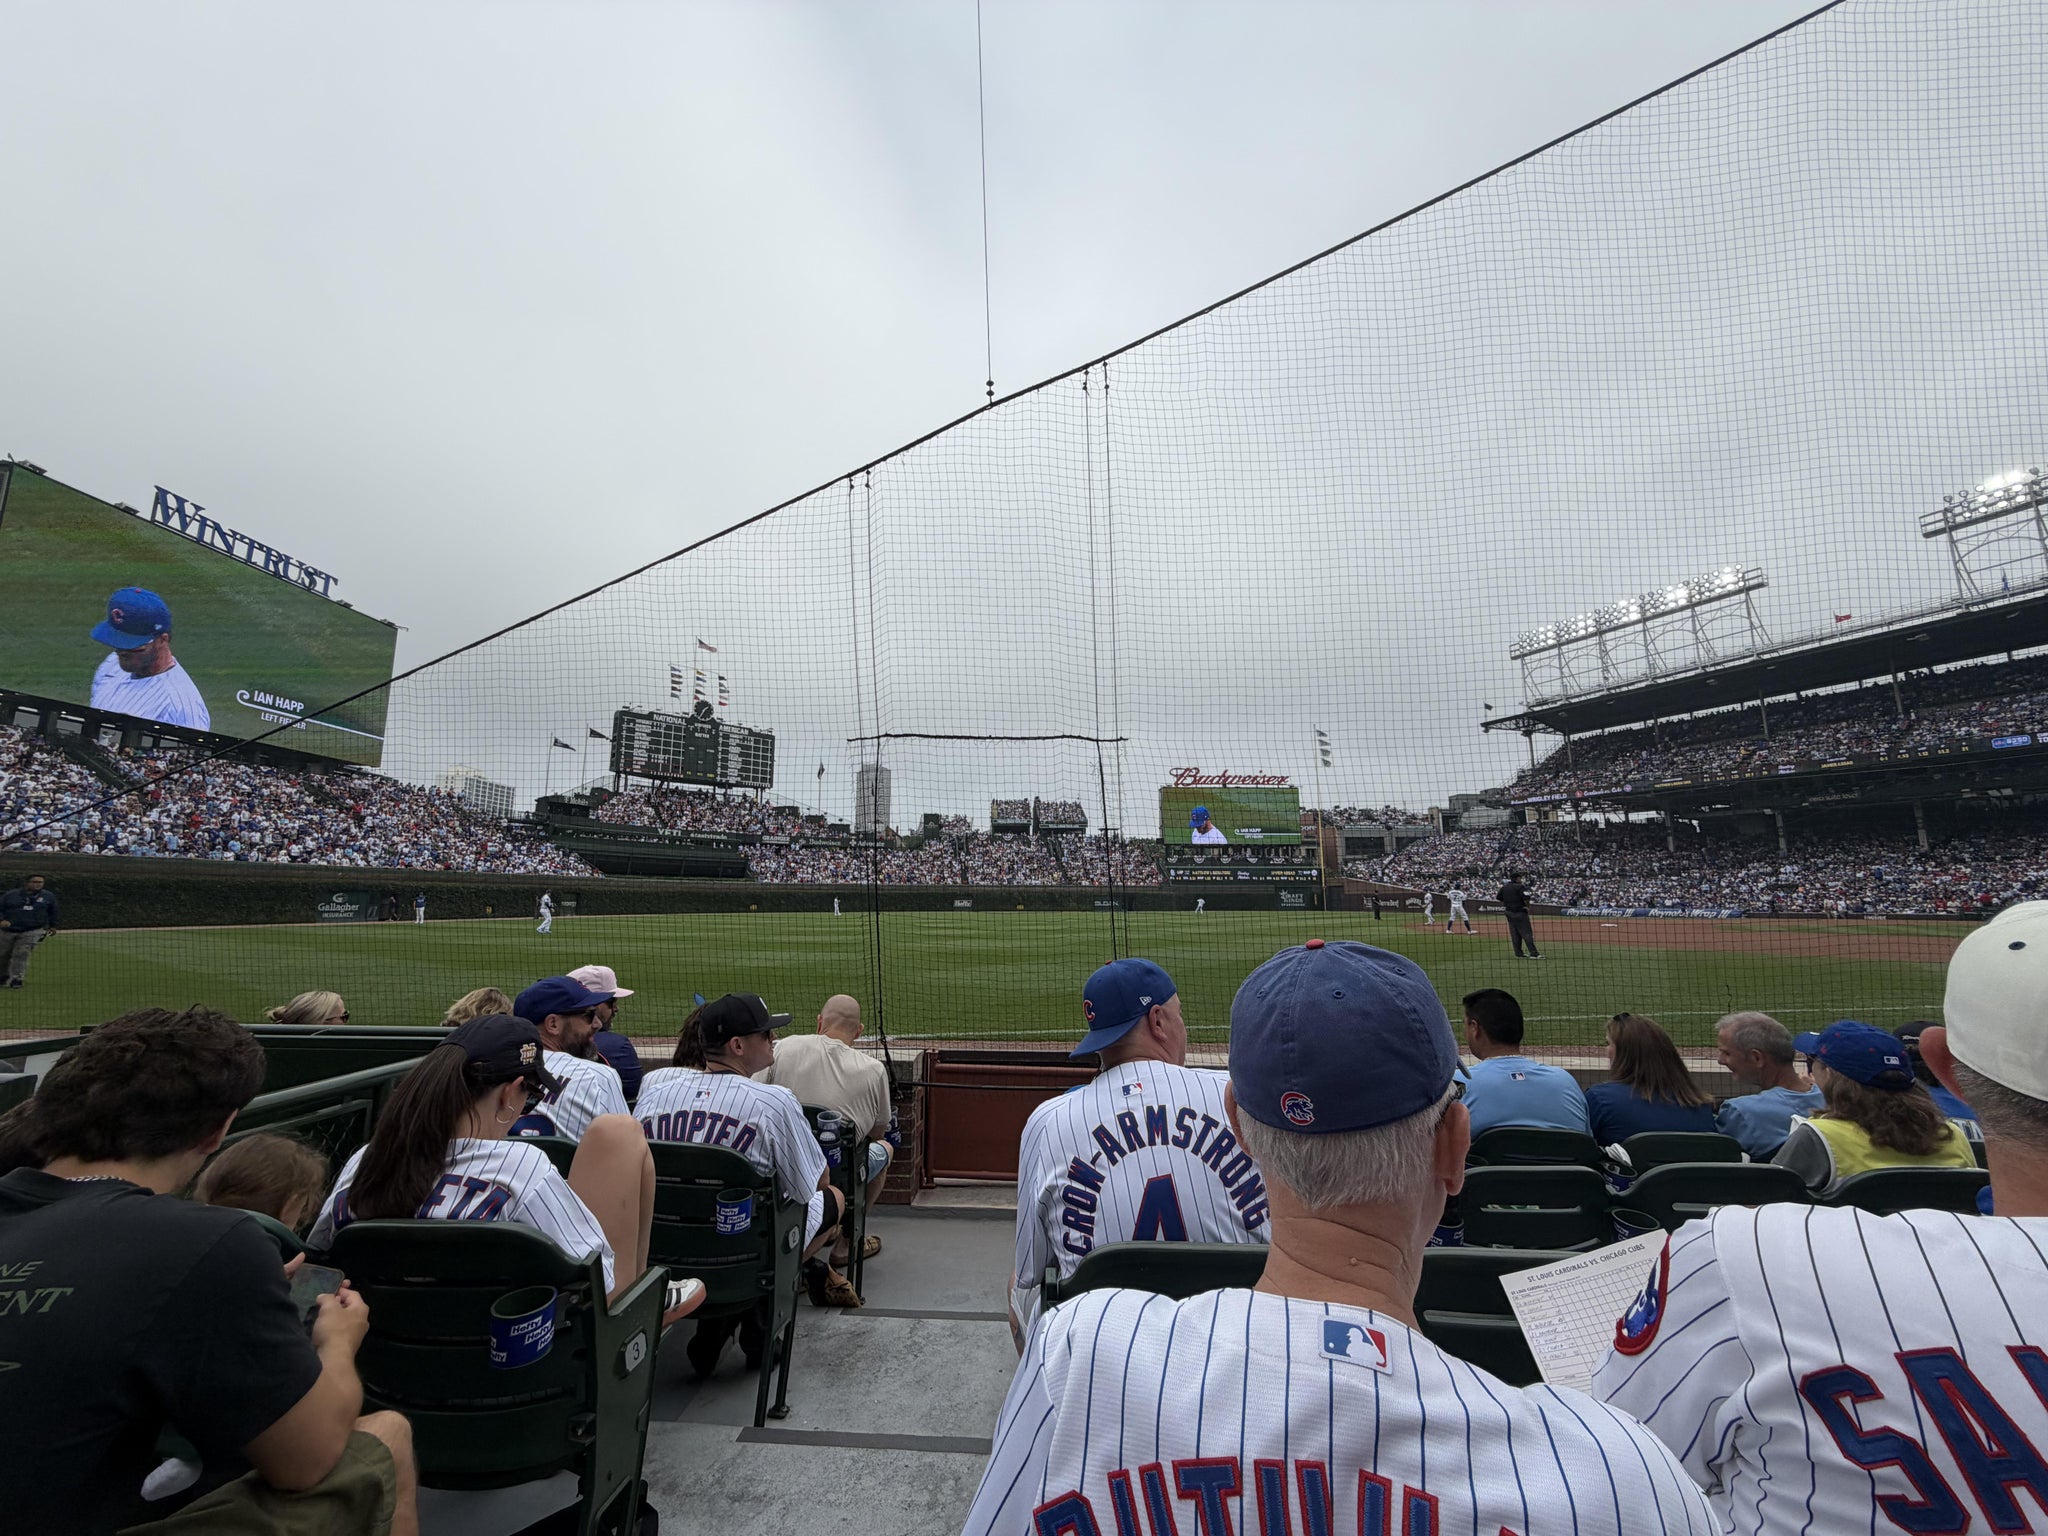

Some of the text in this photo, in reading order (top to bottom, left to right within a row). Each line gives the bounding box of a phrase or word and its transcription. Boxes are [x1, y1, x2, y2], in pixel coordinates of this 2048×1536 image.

[154, 485, 338, 598] WINTRUST
[253, 690, 304, 712] IAN HAPP
[261, 712, 278, 723] LEFT
[653, 713, 687, 725] NATIONAL
[719, 725, 749, 735] AMERICAN
[1169, 767, 1290, 787] Budweiser
[1527, 794, 1550, 803] WRIGLEY
[657, 828, 682, 836] YETI
[857, 840, 885, 848] Advocate
[317, 902, 360, 912] Gallagher
[1567, 908, 1623, 918] Reynolds Wrap
[1690, 909, 1717, 918] Wrap
[1083, 999, 1096, 1022] C
[1061, 1104, 1271, 1257] CROW-ARMSTRONG
[1536, 1271, 1554, 1281] LOUIS
[1554, 1261, 1588, 1276] CARDINALS
[1588, 1258, 1599, 1266] VS.
[1599, 1249, 1627, 1263] CHICAGO
[1628, 1243, 1646, 1253] CUBS
[512, 1315, 540, 1334] Hefty
[526, 1322, 552, 1342] Hefty
[632, 1341, 640, 1361] 3
